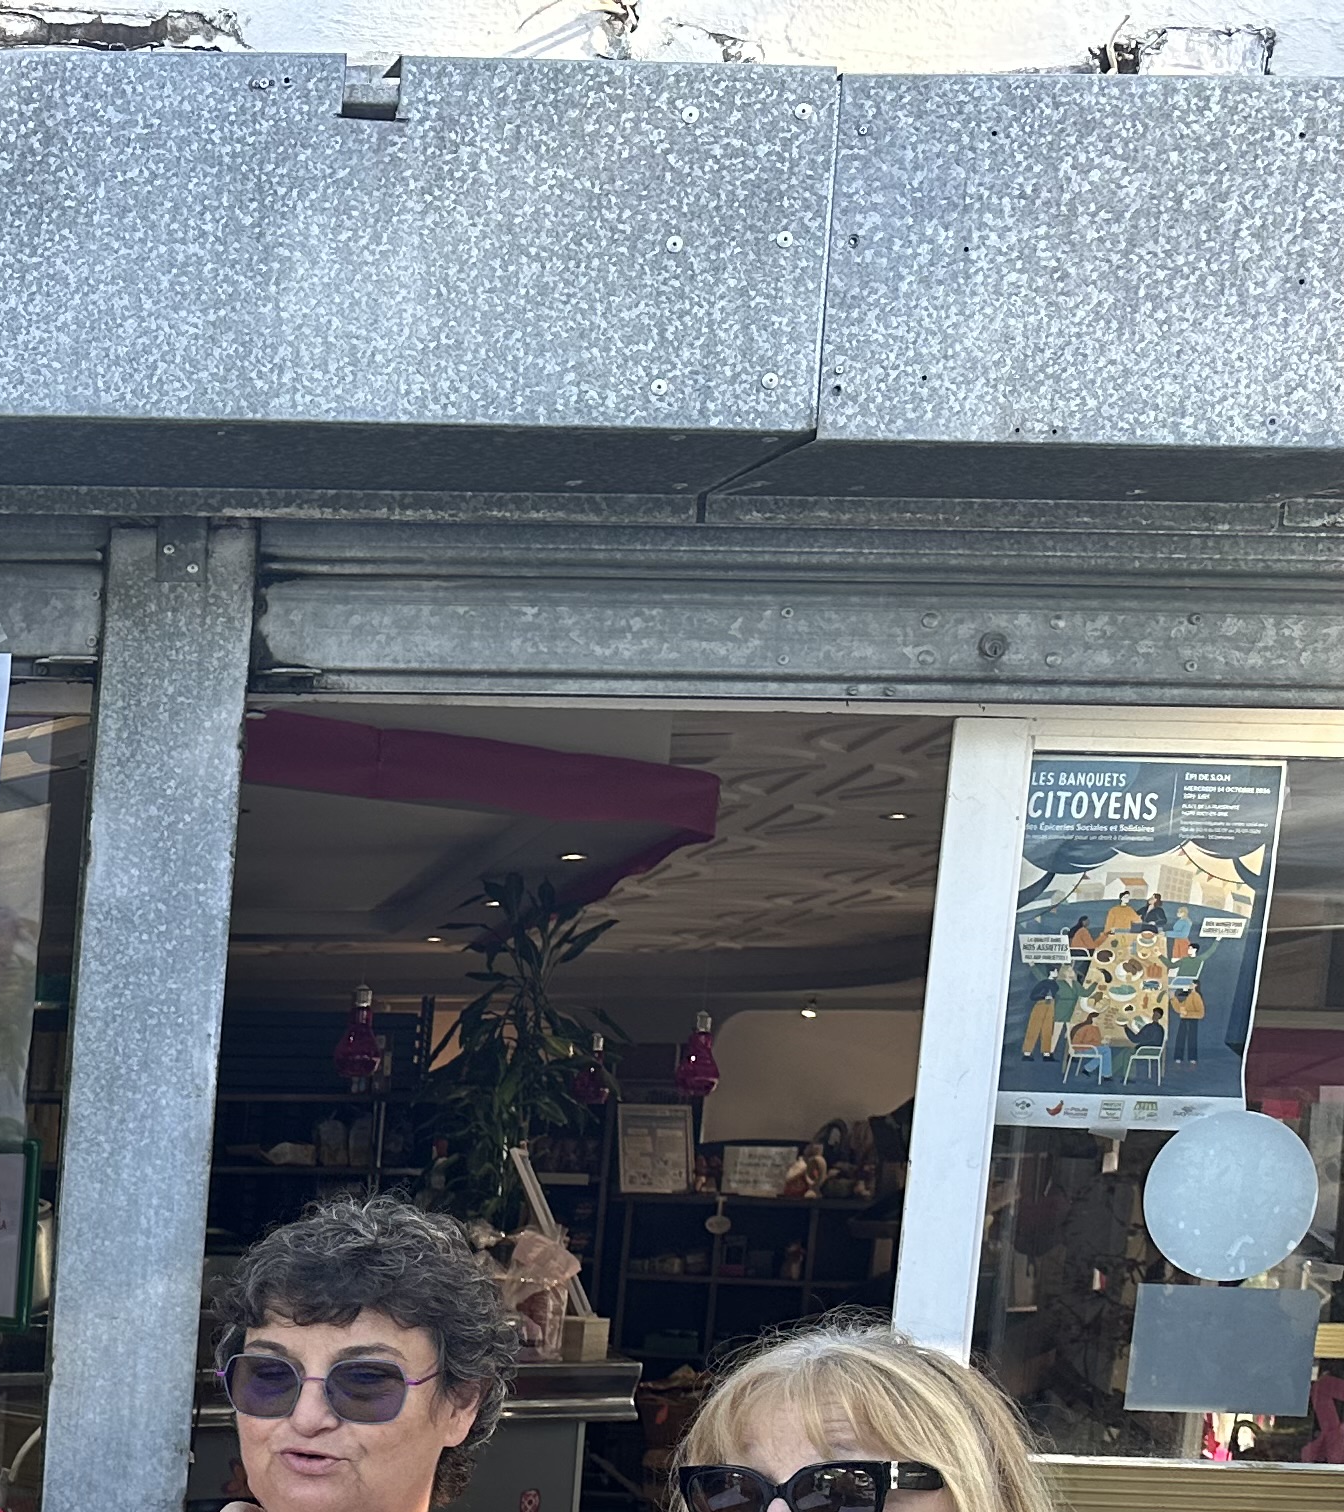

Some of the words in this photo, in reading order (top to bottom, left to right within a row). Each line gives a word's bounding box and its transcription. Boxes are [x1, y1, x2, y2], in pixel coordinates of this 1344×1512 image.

[1031, 771, 1055, 786] LES
[1058, 772, 1127, 788] BANQUETS
[1028, 790, 1159, 820] CITOYENS
